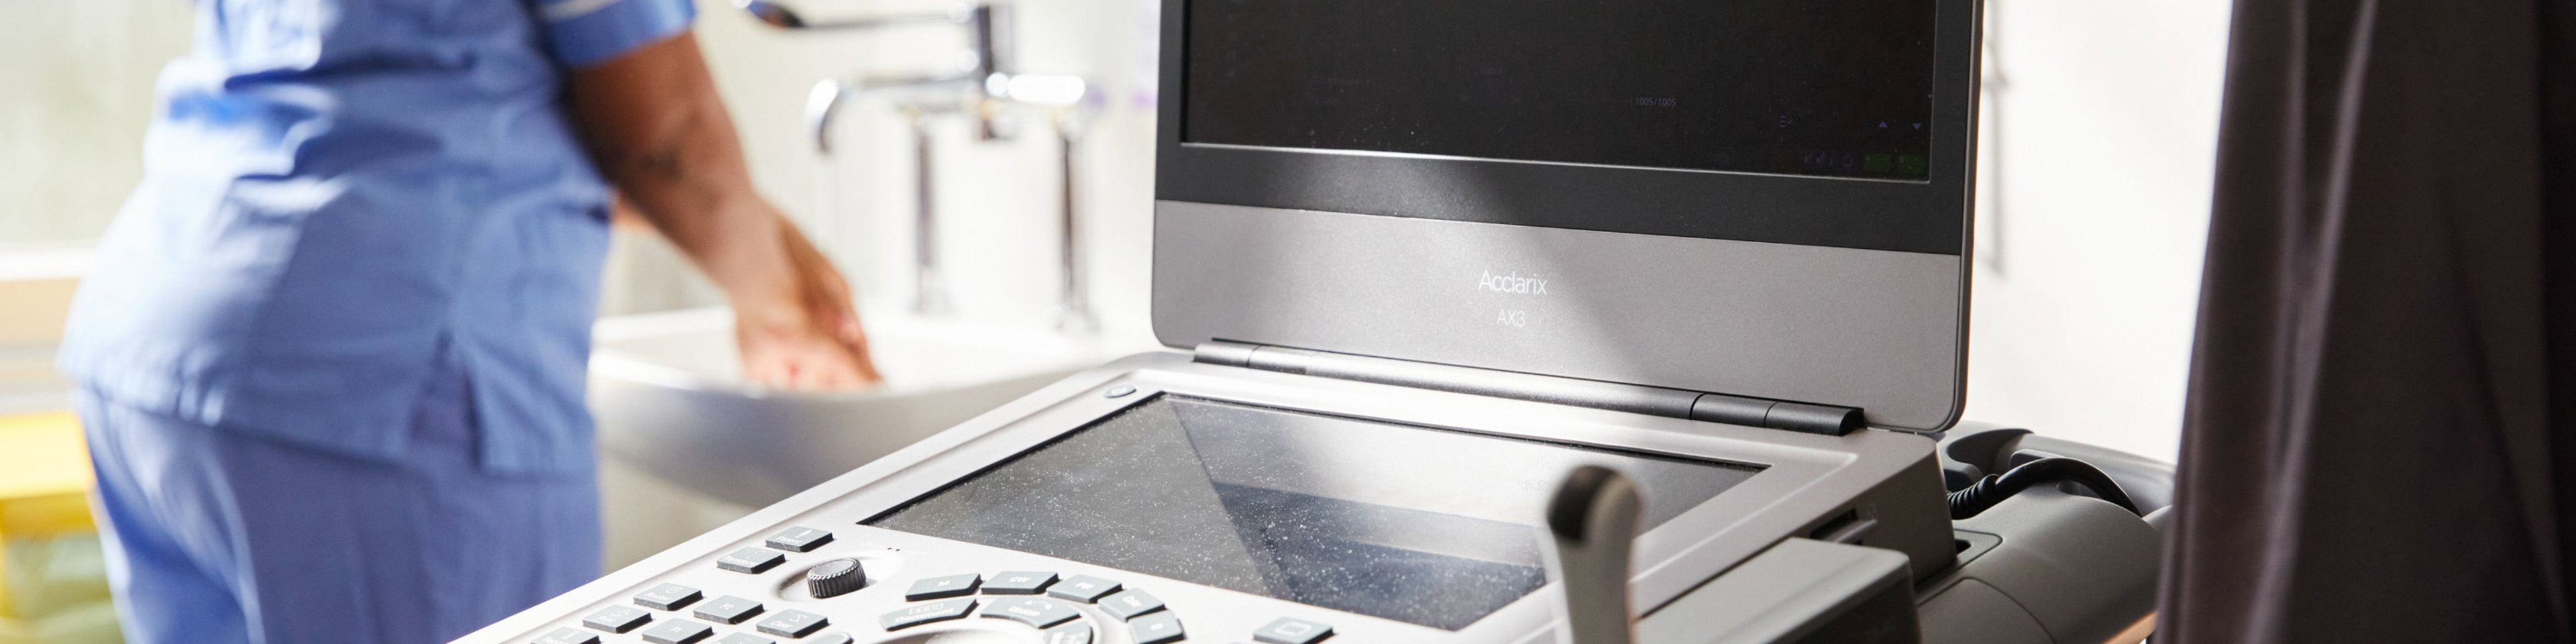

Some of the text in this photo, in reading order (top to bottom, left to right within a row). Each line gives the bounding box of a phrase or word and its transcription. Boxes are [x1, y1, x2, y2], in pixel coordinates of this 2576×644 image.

[1635, 97, 1676, 107] 1005/1005
[1479, 270, 1548, 295] Acclarix
[1497, 309, 1525, 327] AX3
